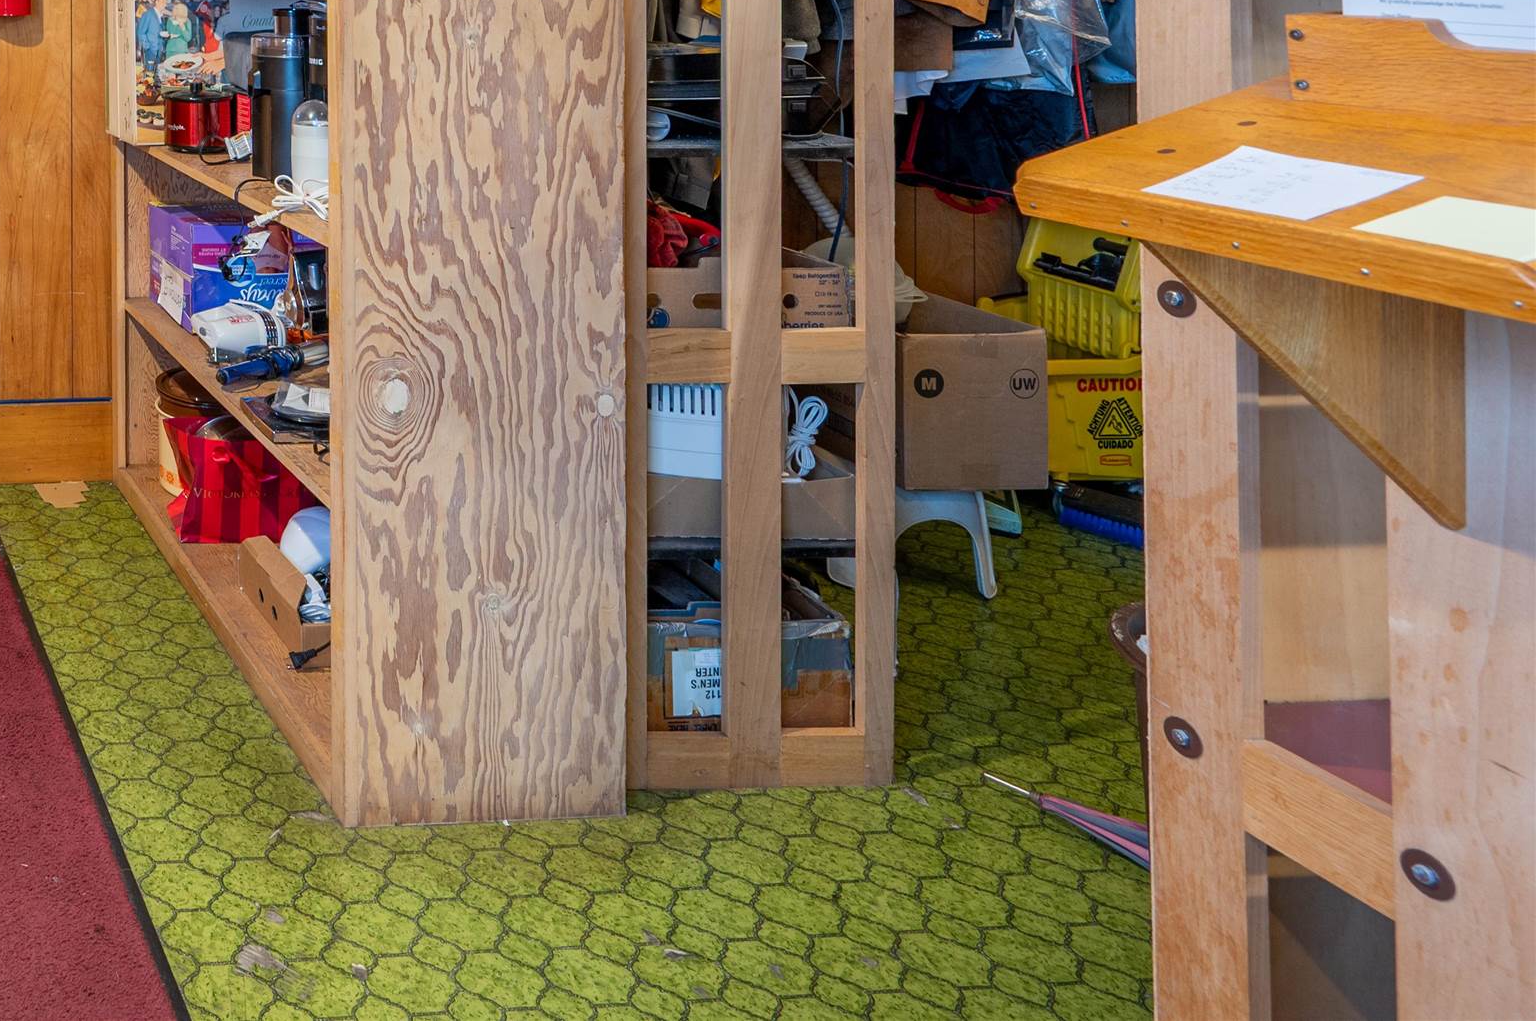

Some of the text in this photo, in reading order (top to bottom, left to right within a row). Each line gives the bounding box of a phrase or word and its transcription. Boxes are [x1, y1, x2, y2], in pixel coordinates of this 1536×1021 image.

[921, 377, 1036, 390] M UW
[1087, 399, 1110, 435] ACHTUNG
[1097, 440, 1133, 449] CUIDADO
[695, 667, 720, 677] NTER
